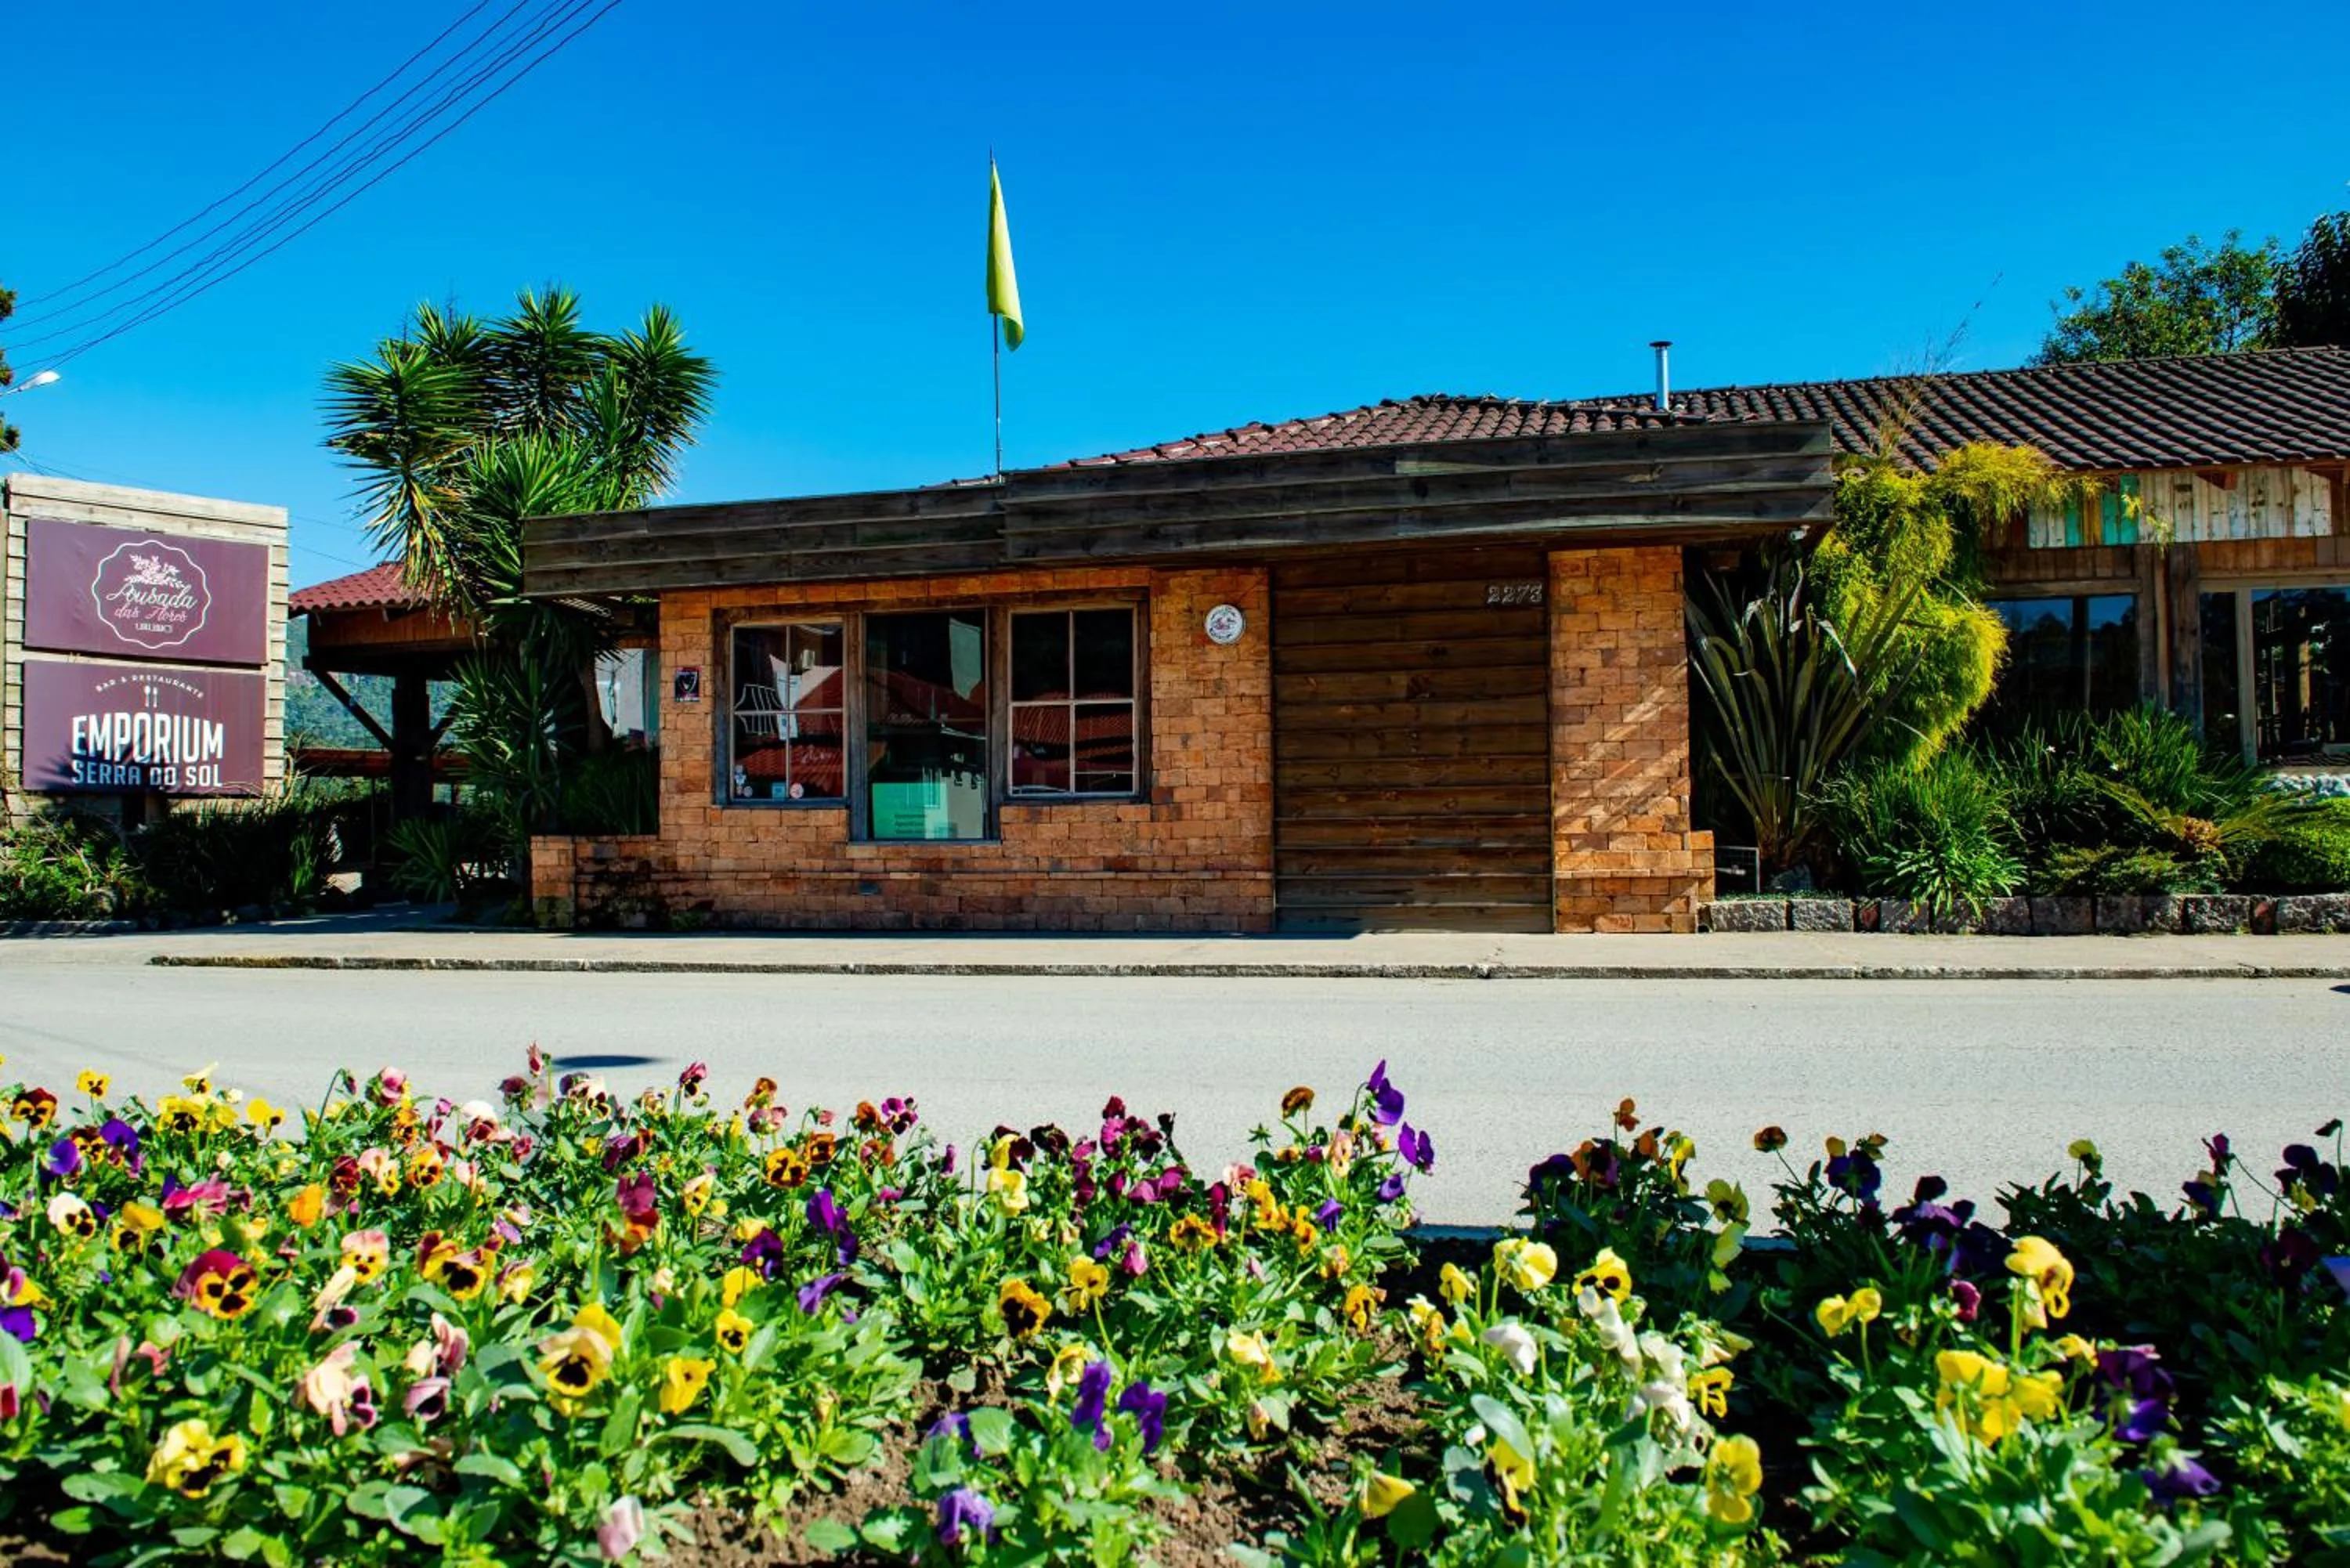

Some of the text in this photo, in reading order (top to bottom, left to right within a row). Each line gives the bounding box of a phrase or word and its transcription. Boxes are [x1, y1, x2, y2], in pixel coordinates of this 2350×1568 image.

[106, 582, 197, 610] Pousada
[114, 602, 188, 623] das Flores
[95, 678, 117, 693] BAR
[131, 674, 204, 699] RESTAURANTE
[72, 712, 224, 764] EMPORIUM
[72, 760, 142, 786] SERRA
[186, 763, 223, 788] SOL
